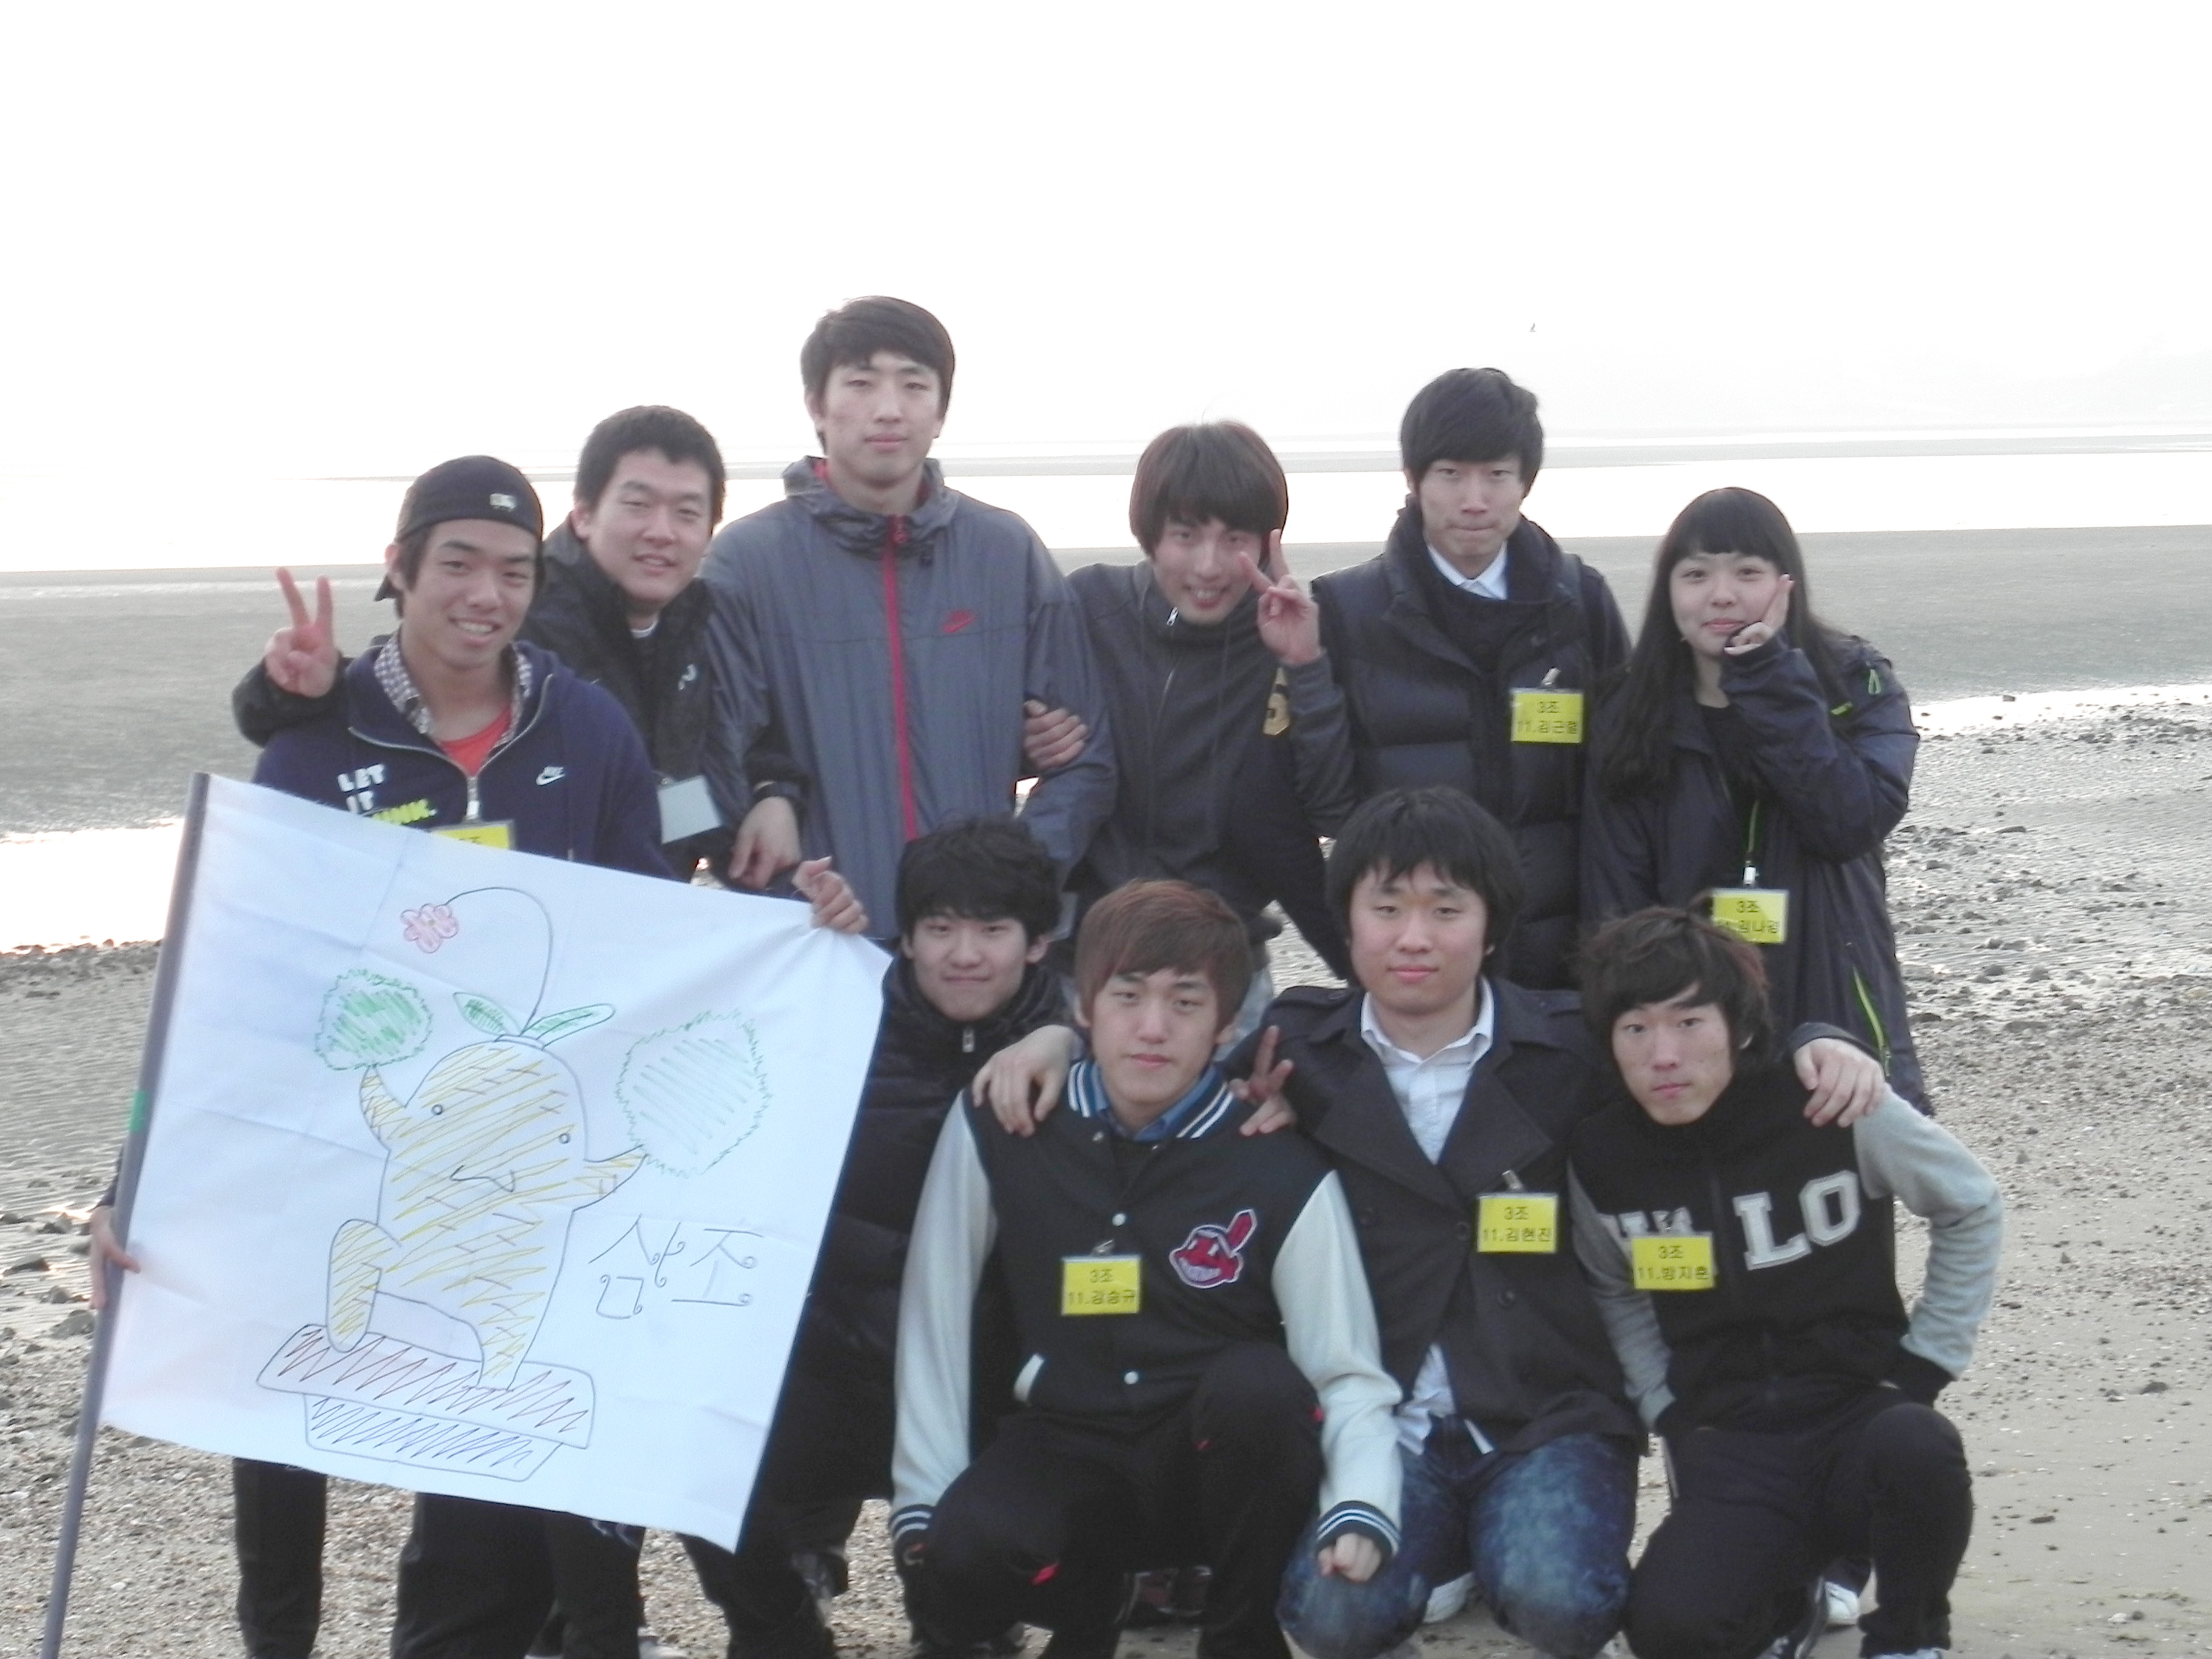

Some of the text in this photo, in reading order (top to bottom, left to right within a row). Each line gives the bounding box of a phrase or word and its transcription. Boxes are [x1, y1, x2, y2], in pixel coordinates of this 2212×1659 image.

[1537, 701, 1559, 713] 3조
[337, 763, 386, 793] LET
[346, 790, 375, 814] IT
[1736, 900, 1760, 913] 3조
[1504, 1206, 1529, 1221] 3조
[1658, 1245, 1684, 1259] 3조
[588, 1213, 765, 1319] 삼조
[1090, 1268, 1113, 1283] 3조
